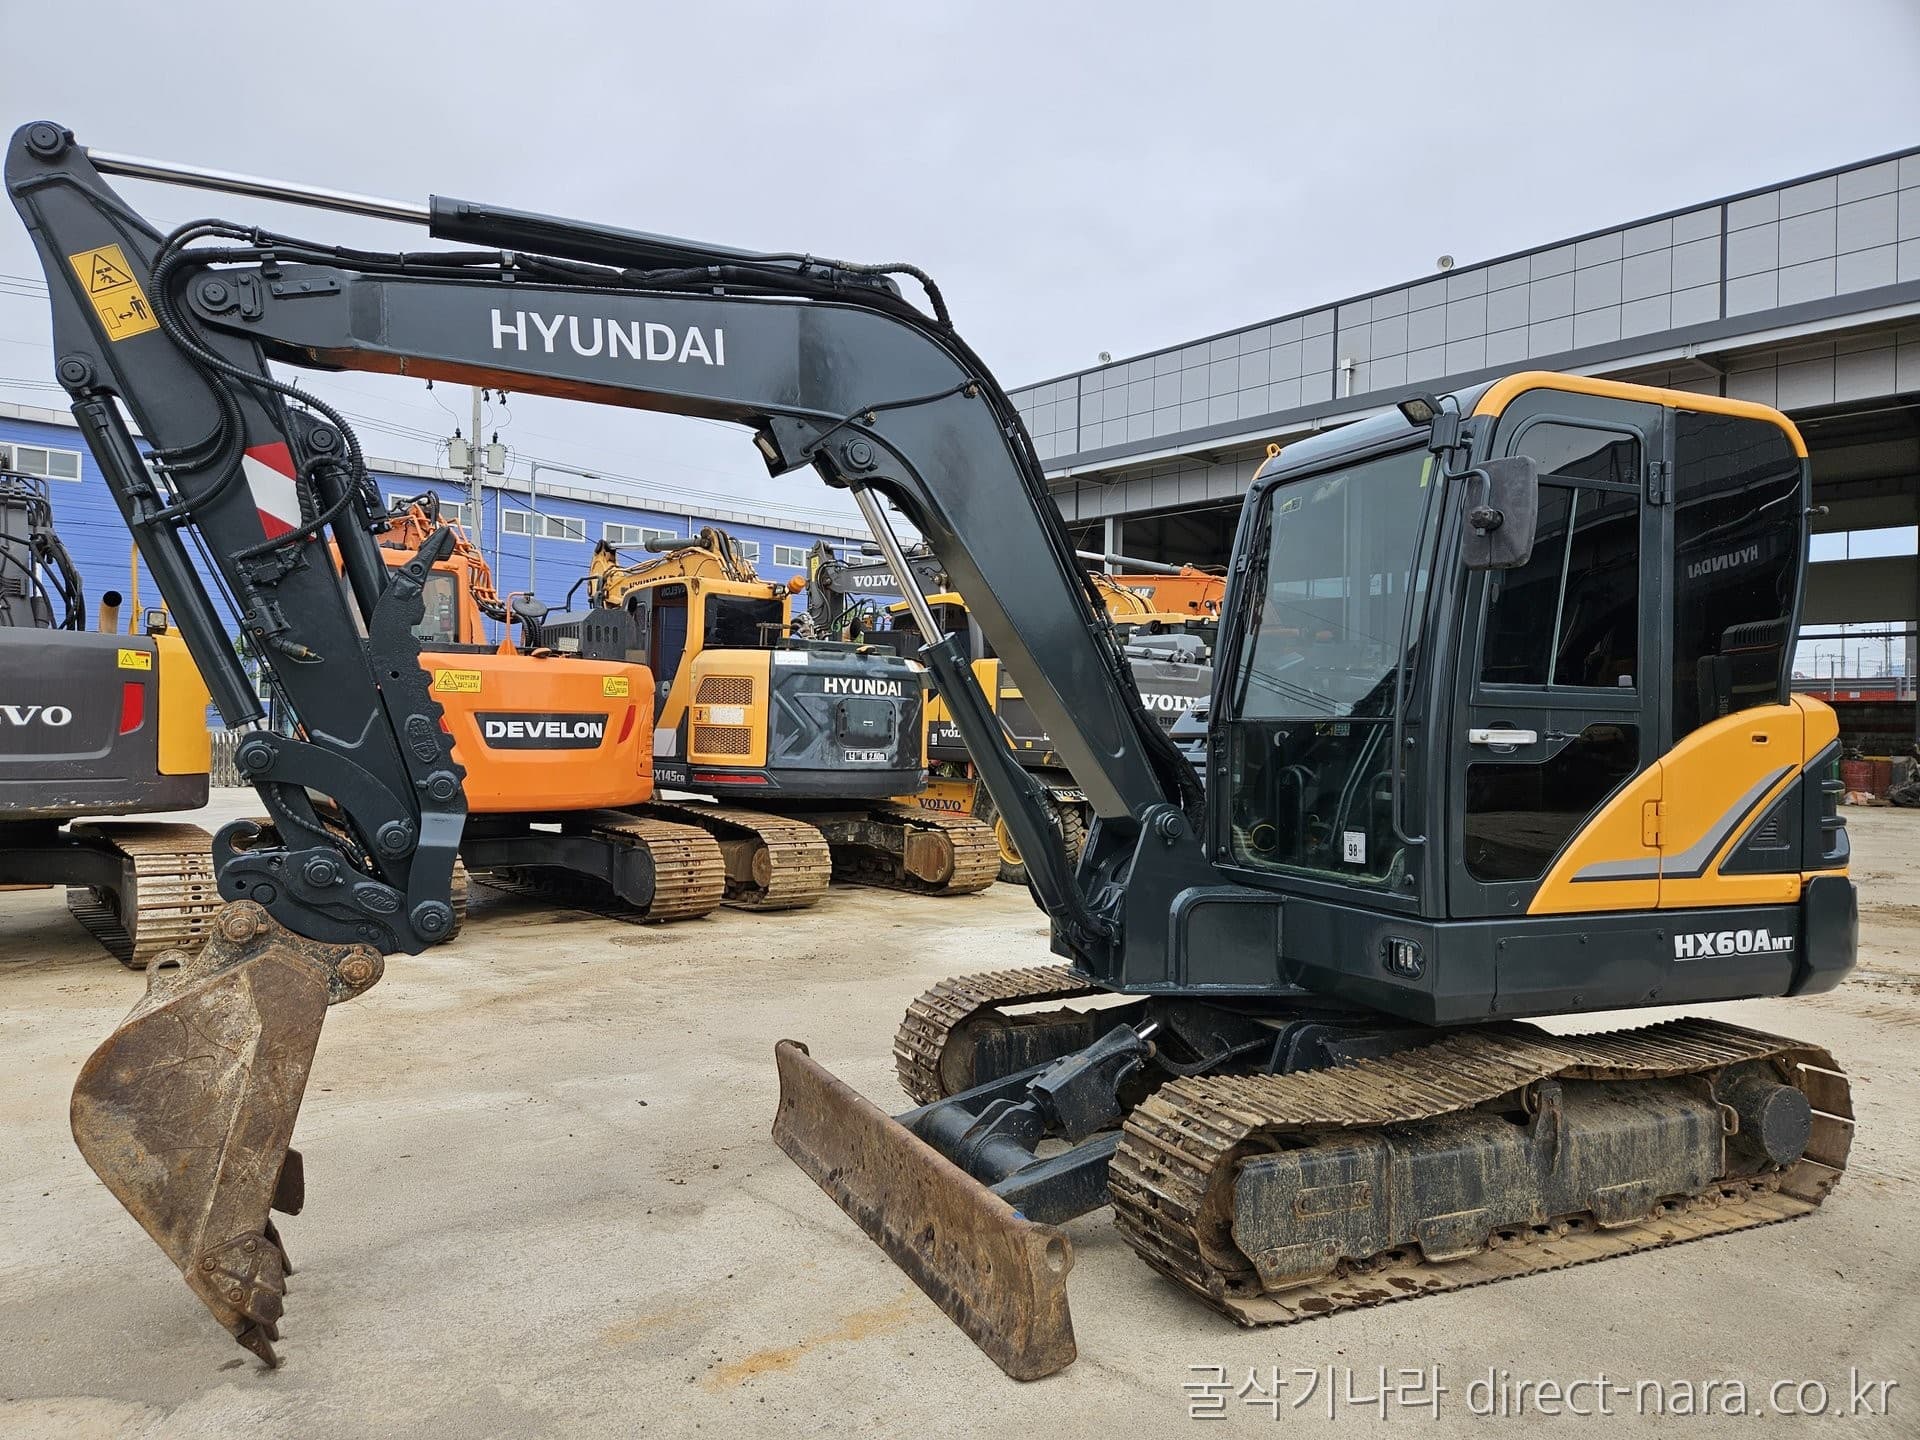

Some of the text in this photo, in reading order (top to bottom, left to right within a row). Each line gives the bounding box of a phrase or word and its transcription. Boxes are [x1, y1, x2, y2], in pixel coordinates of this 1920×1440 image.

[491, 308, 725, 366] HYUNDAI
[824, 677, 902, 697] HYUNDAI
[0, 704, 73, 726] VO
[485, 721, 603, 738] DEVELON
[652, 769, 685, 782] X145CR
[919, 798, 962, 811] VOLVO
[1348, 843, 1358, 857] 98
